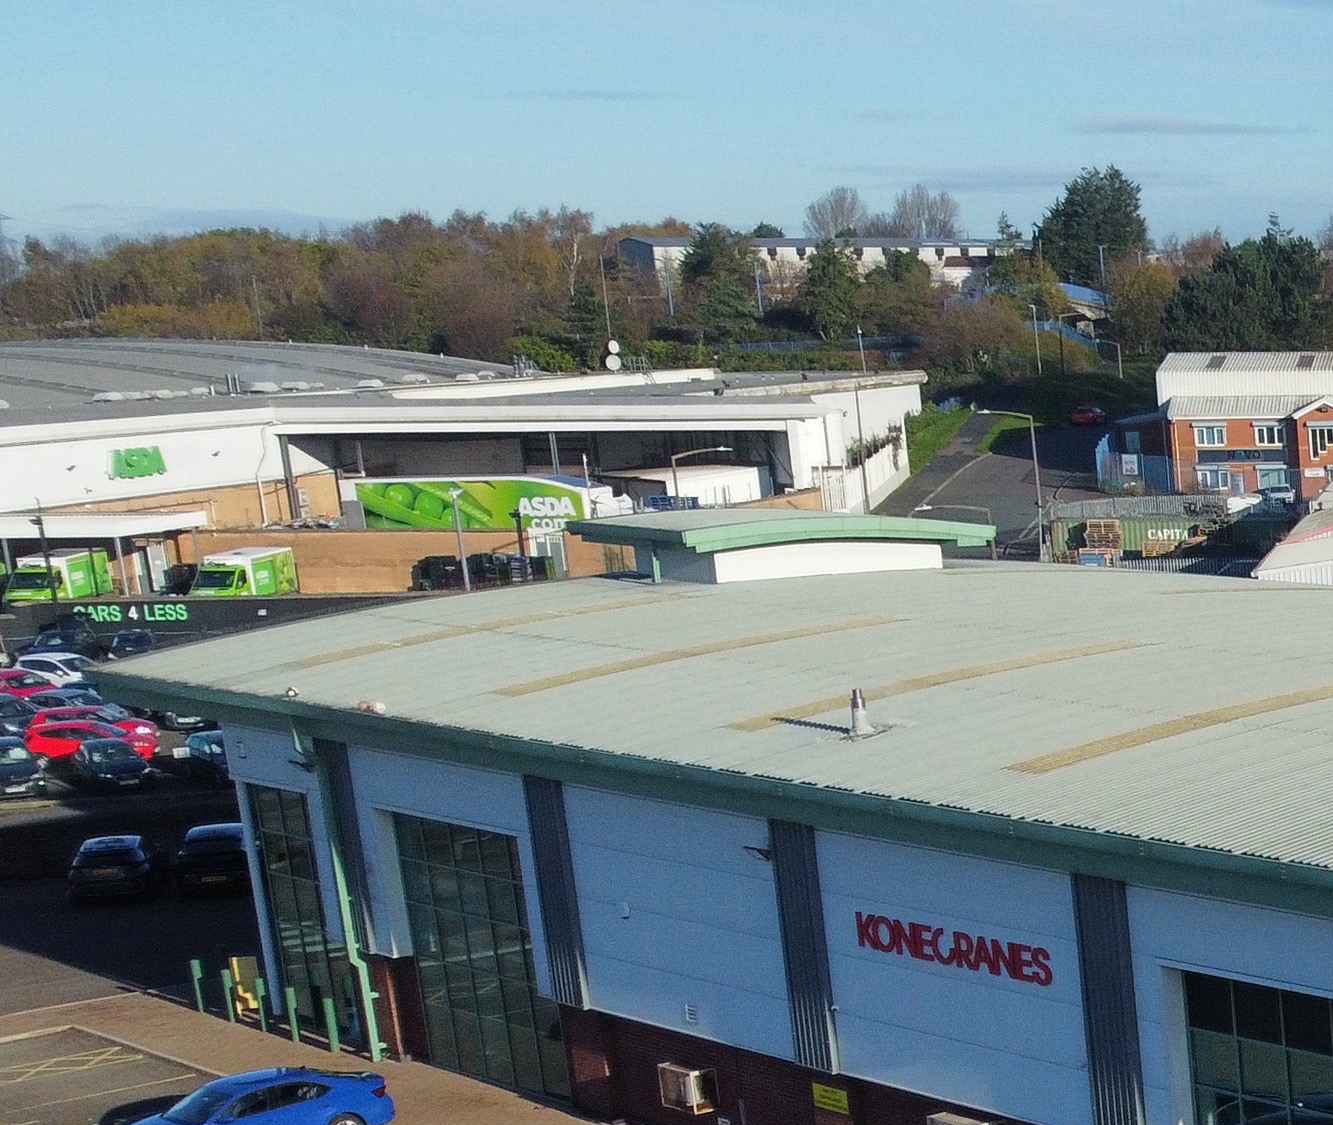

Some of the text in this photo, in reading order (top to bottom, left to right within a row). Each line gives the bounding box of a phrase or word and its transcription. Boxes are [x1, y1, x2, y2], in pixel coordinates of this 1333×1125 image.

[108, 446, 167, 480] ASDA
[518, 496, 577, 517] ASDA
[1147, 528, 1189, 540] CAPITA
[127, 606, 138, 620] 4
[144, 603, 188, 622] LESS
[855, 911, 1054, 987] KONECRANES
